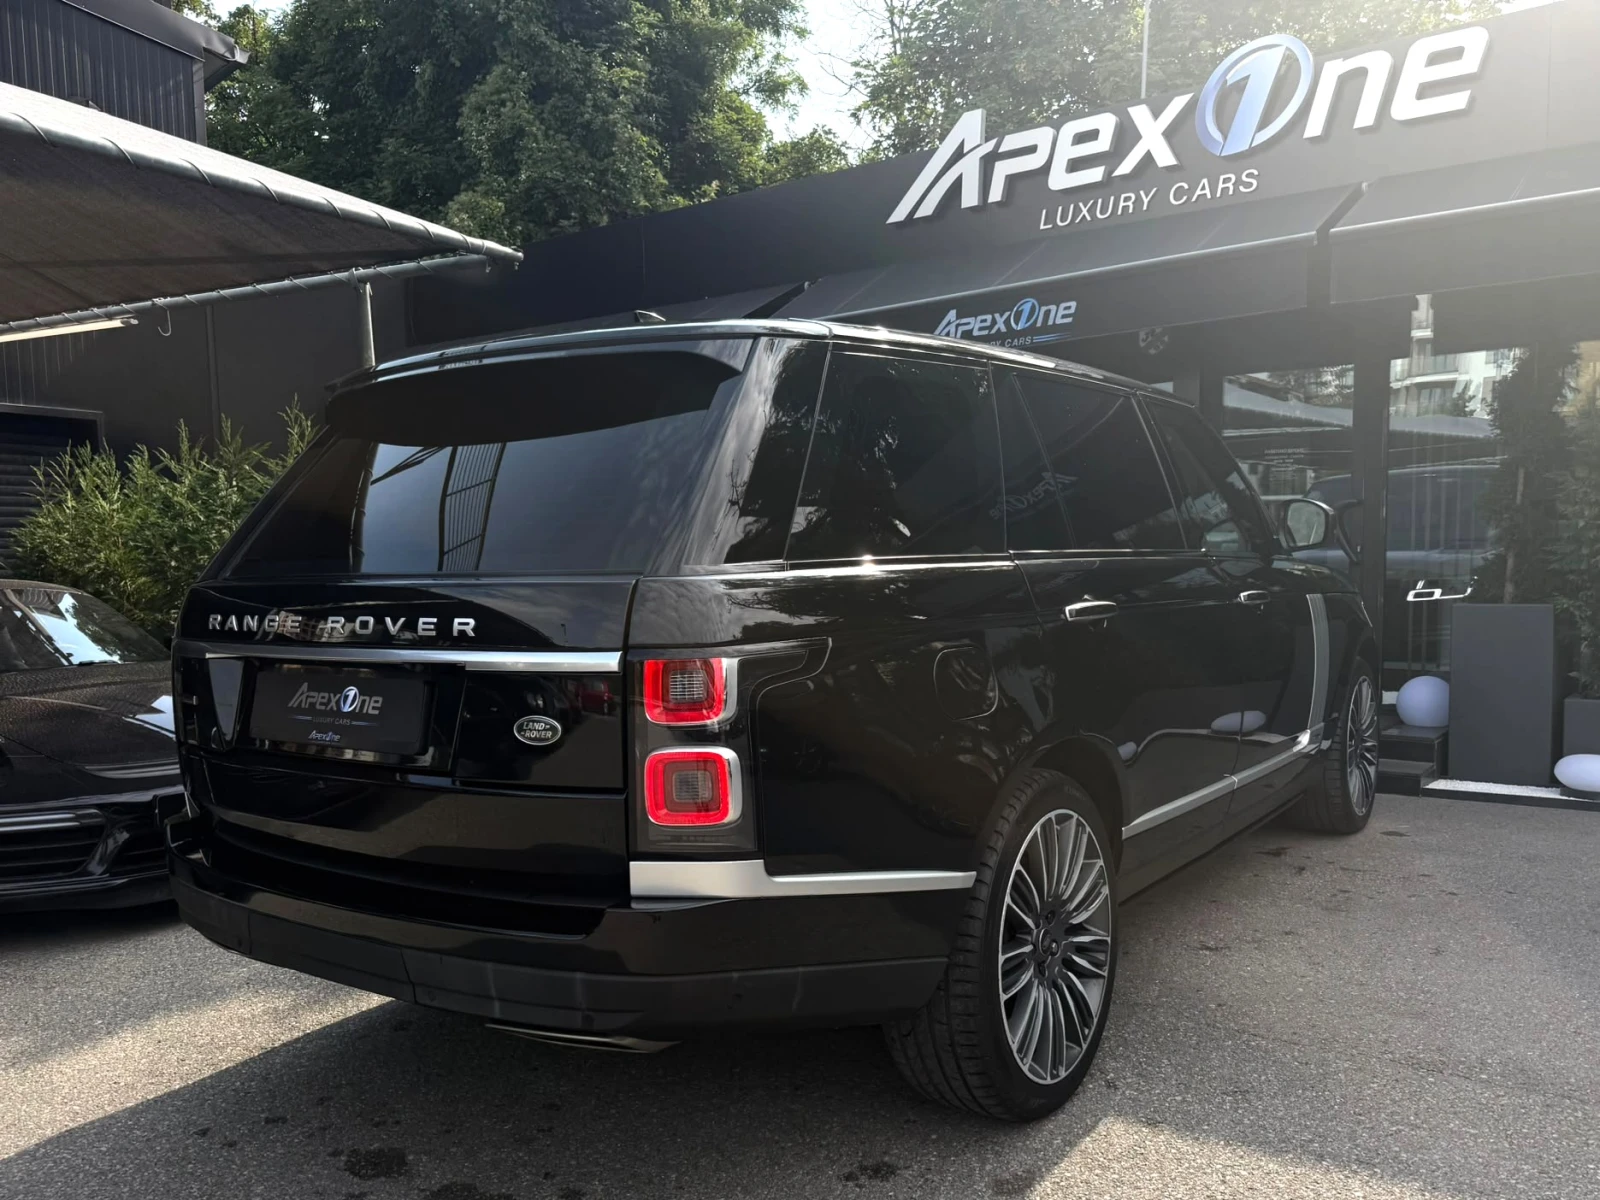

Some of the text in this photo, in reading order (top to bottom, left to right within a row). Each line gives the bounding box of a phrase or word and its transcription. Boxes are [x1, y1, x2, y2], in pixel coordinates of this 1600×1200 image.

[1038, 170, 1259, 230] LUXURY CARS
[1004, 336, 1032, 348] CARS
[208, 614, 476, 637] RANGE ROVER
[334, 717, 351, 726] CARS
